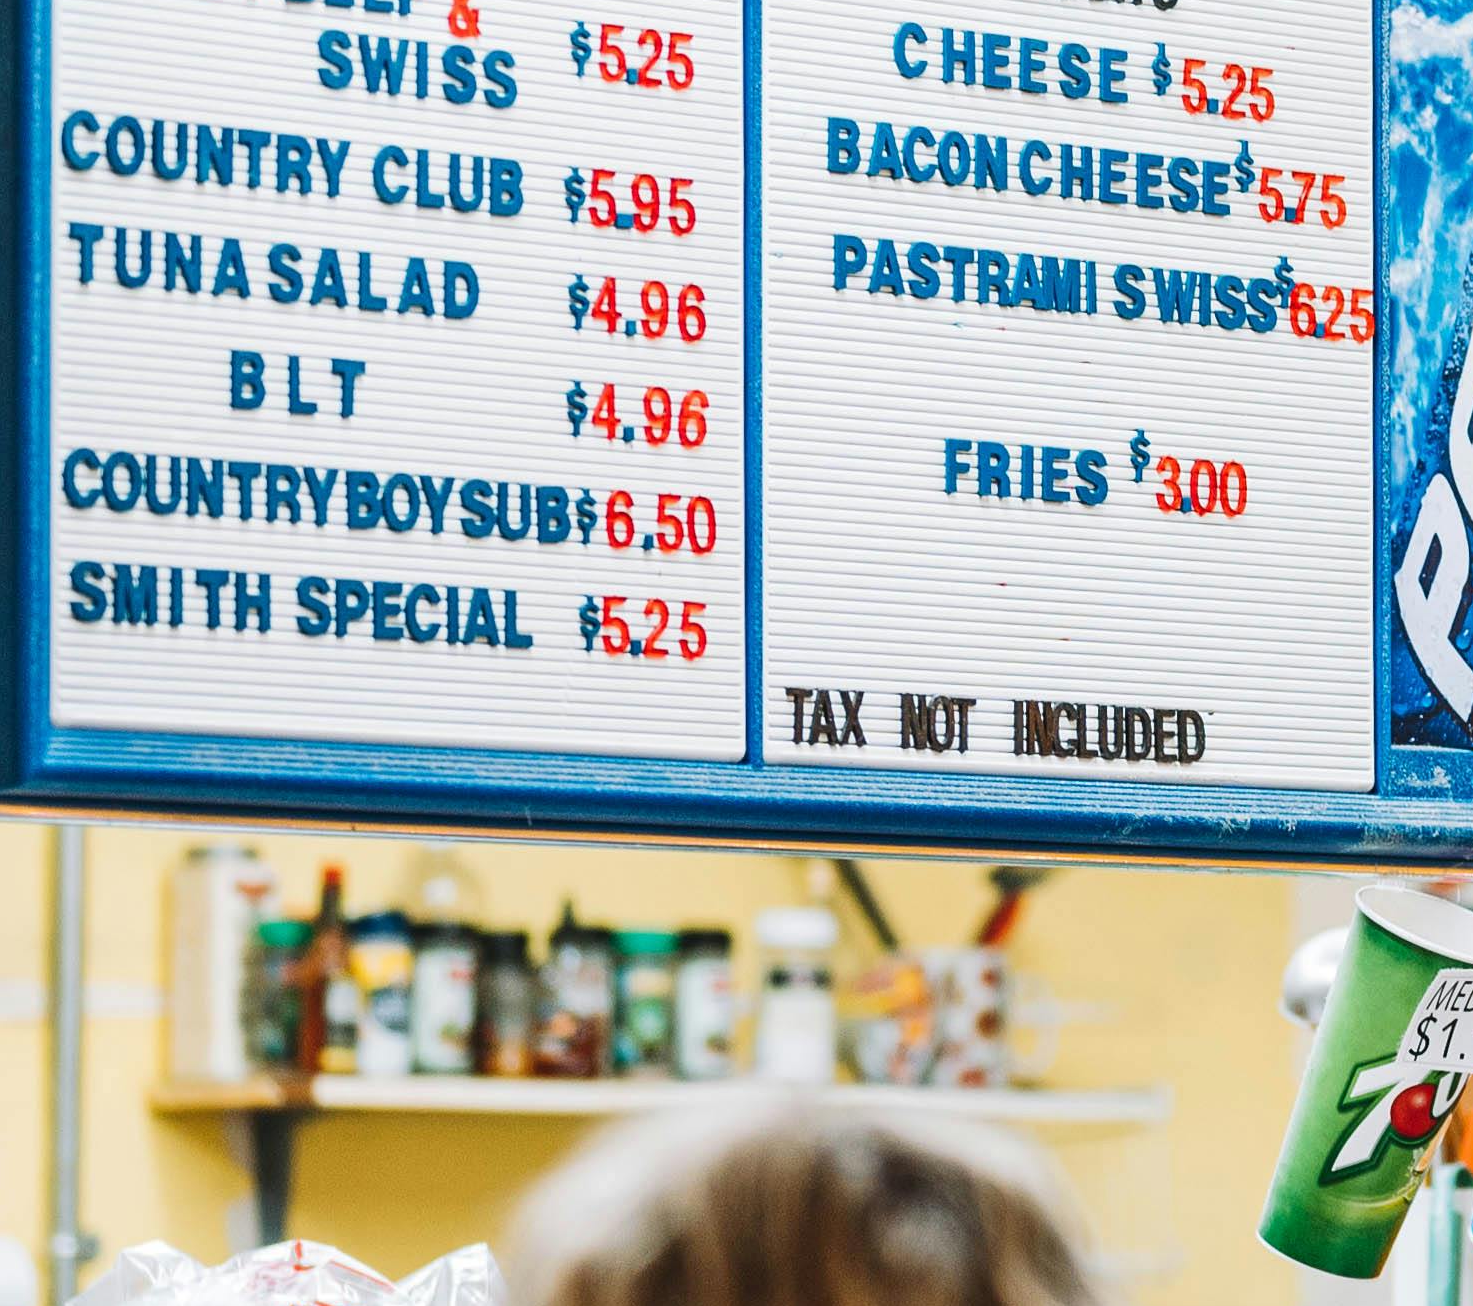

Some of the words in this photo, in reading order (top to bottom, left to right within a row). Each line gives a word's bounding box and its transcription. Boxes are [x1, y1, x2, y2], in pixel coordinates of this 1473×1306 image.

[317, 29, 518, 110] SWISS
[569, 20, 695, 91] $5.25
[893, 21, 1128, 102] CHEESE
[1151, 41, 1275, 122] $5.25
[61, 110, 350, 198] COUNTRY
[371, 144, 525, 217] CLUB
[565, 166, 697, 236] $5.95
[1234, 139, 1347, 229] $5.75
[68, 221, 251, 299] TUNA
[267, 243, 480, 321] SALAD
[566, 273, 707, 344] $4.96
[832, 234, 1097, 315] PASTRAMI
[1113, 263, 1278, 334] SWISS
[1274, 256, 1375, 343] $6.25
[566, 380, 709, 449] $4.96
[944, 437, 1108, 507] FRIES
[1128, 429, 1249, 518] $3.00
[575, 487, 717, 555] $6.50
[68, 560, 272, 635] SMITH
[296, 575, 533, 650] SPECIAL
[578, 594, 709, 661] $5.25
[785, 687, 866, 750] TAX
[899, 692, 976, 755] NOT
[1013, 699, 1207, 764] INCLUDED
